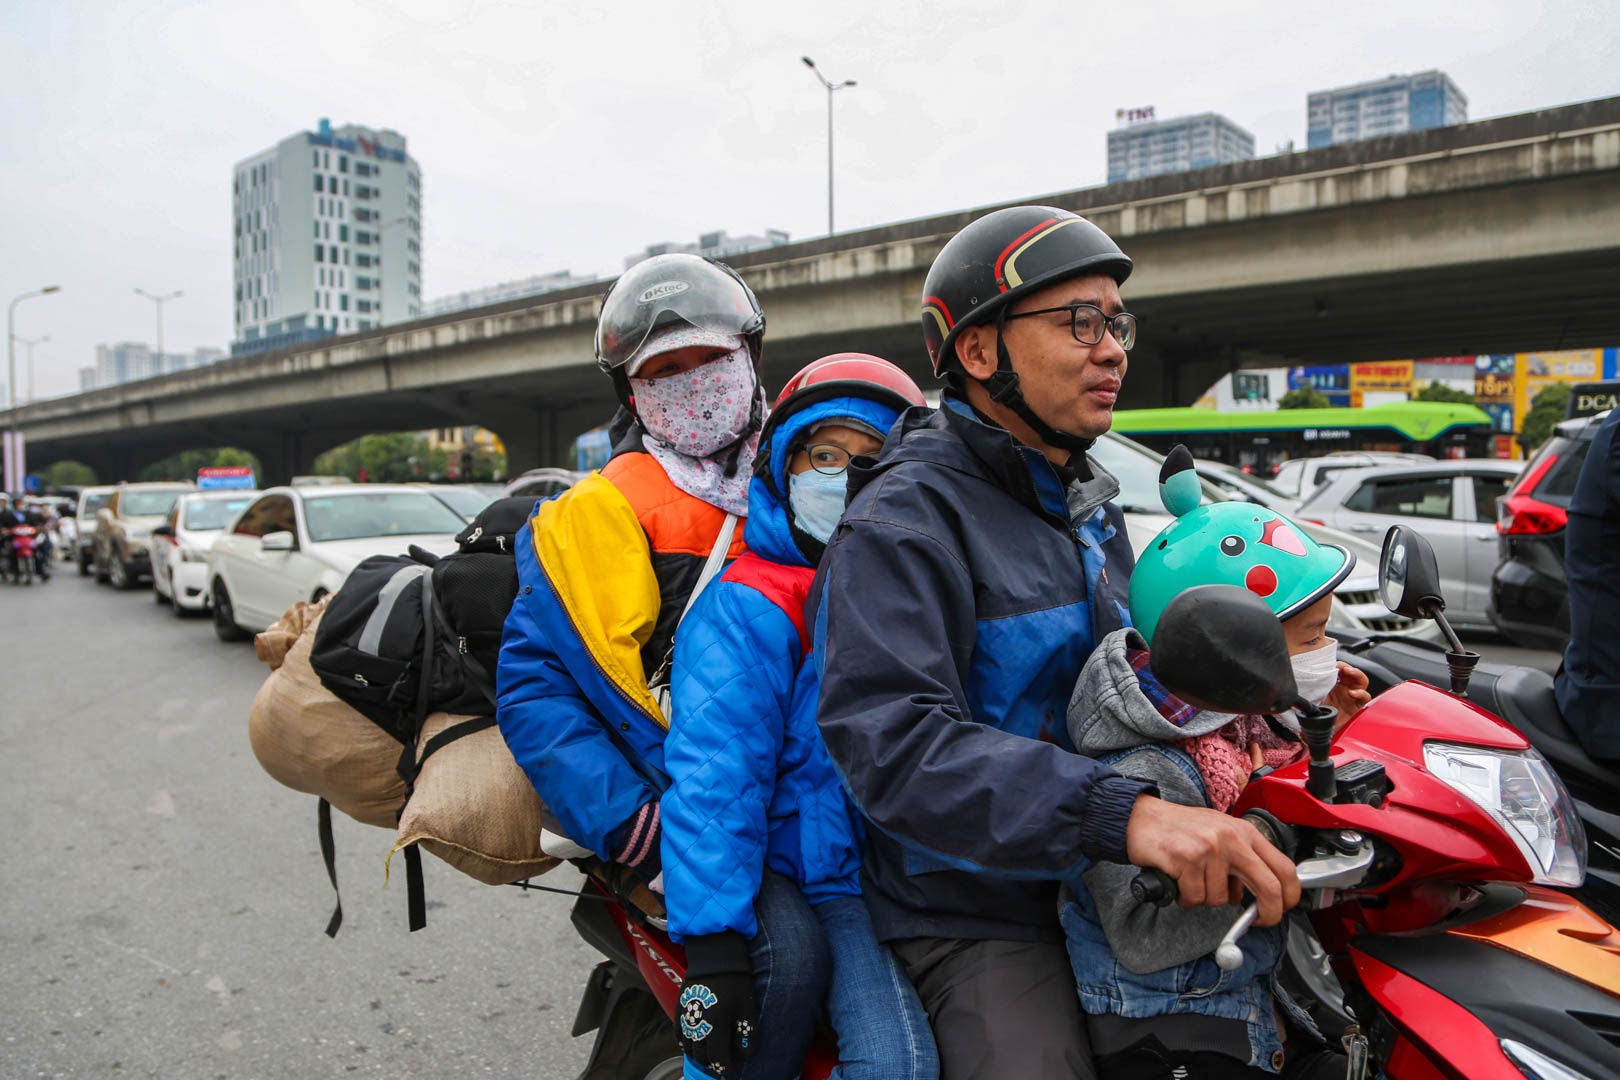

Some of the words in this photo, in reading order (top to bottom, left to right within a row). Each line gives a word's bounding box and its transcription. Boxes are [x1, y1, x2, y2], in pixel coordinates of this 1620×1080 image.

[1577, 394, 1620, 411] DCA
[626, 920, 683, 988] VISIO
[741, 1037, 749, 1048] 5
